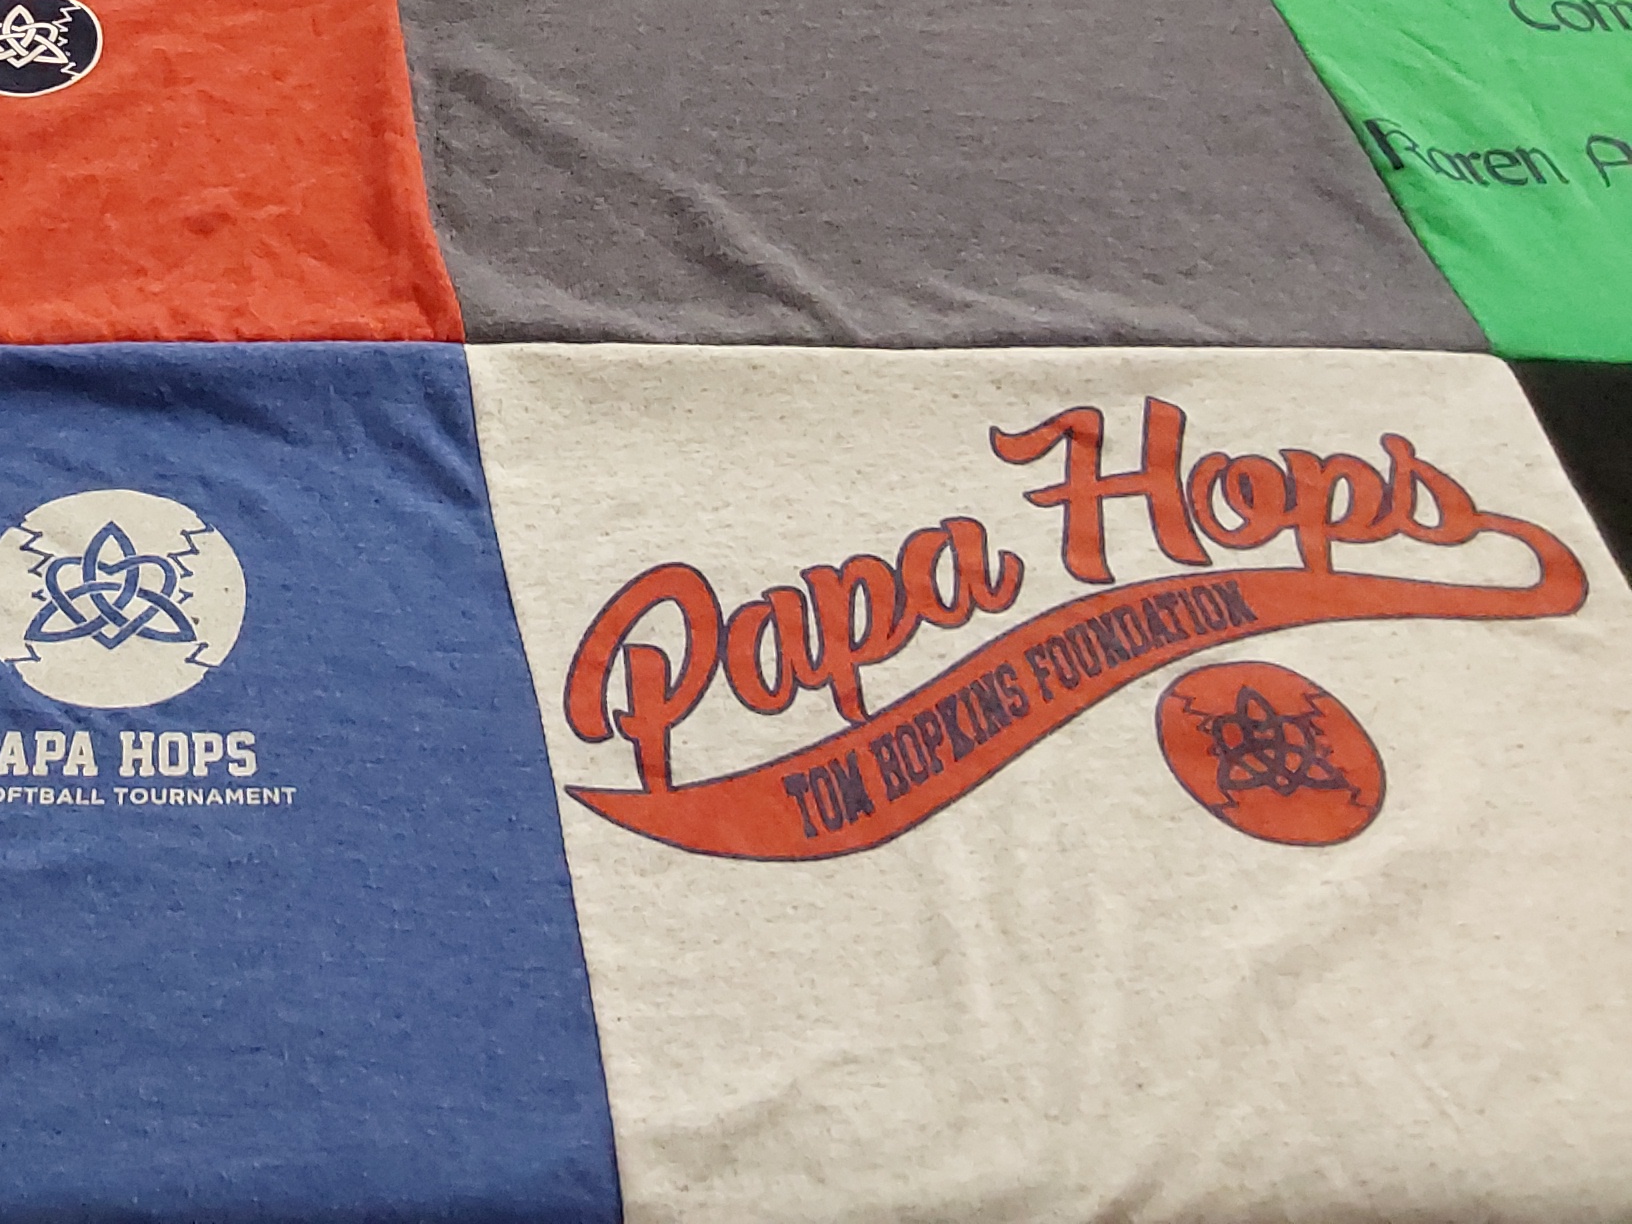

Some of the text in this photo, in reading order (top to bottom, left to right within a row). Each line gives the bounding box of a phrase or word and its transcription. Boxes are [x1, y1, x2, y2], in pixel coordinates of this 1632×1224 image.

[563, 396, 1488, 793] Papa Hops
[119, 729, 258, 777] HOPS
[782, 578, 1260, 840] TOM HOPKINS FOUNDATION
[113, 785, 297, 806] TOURNAMENT
